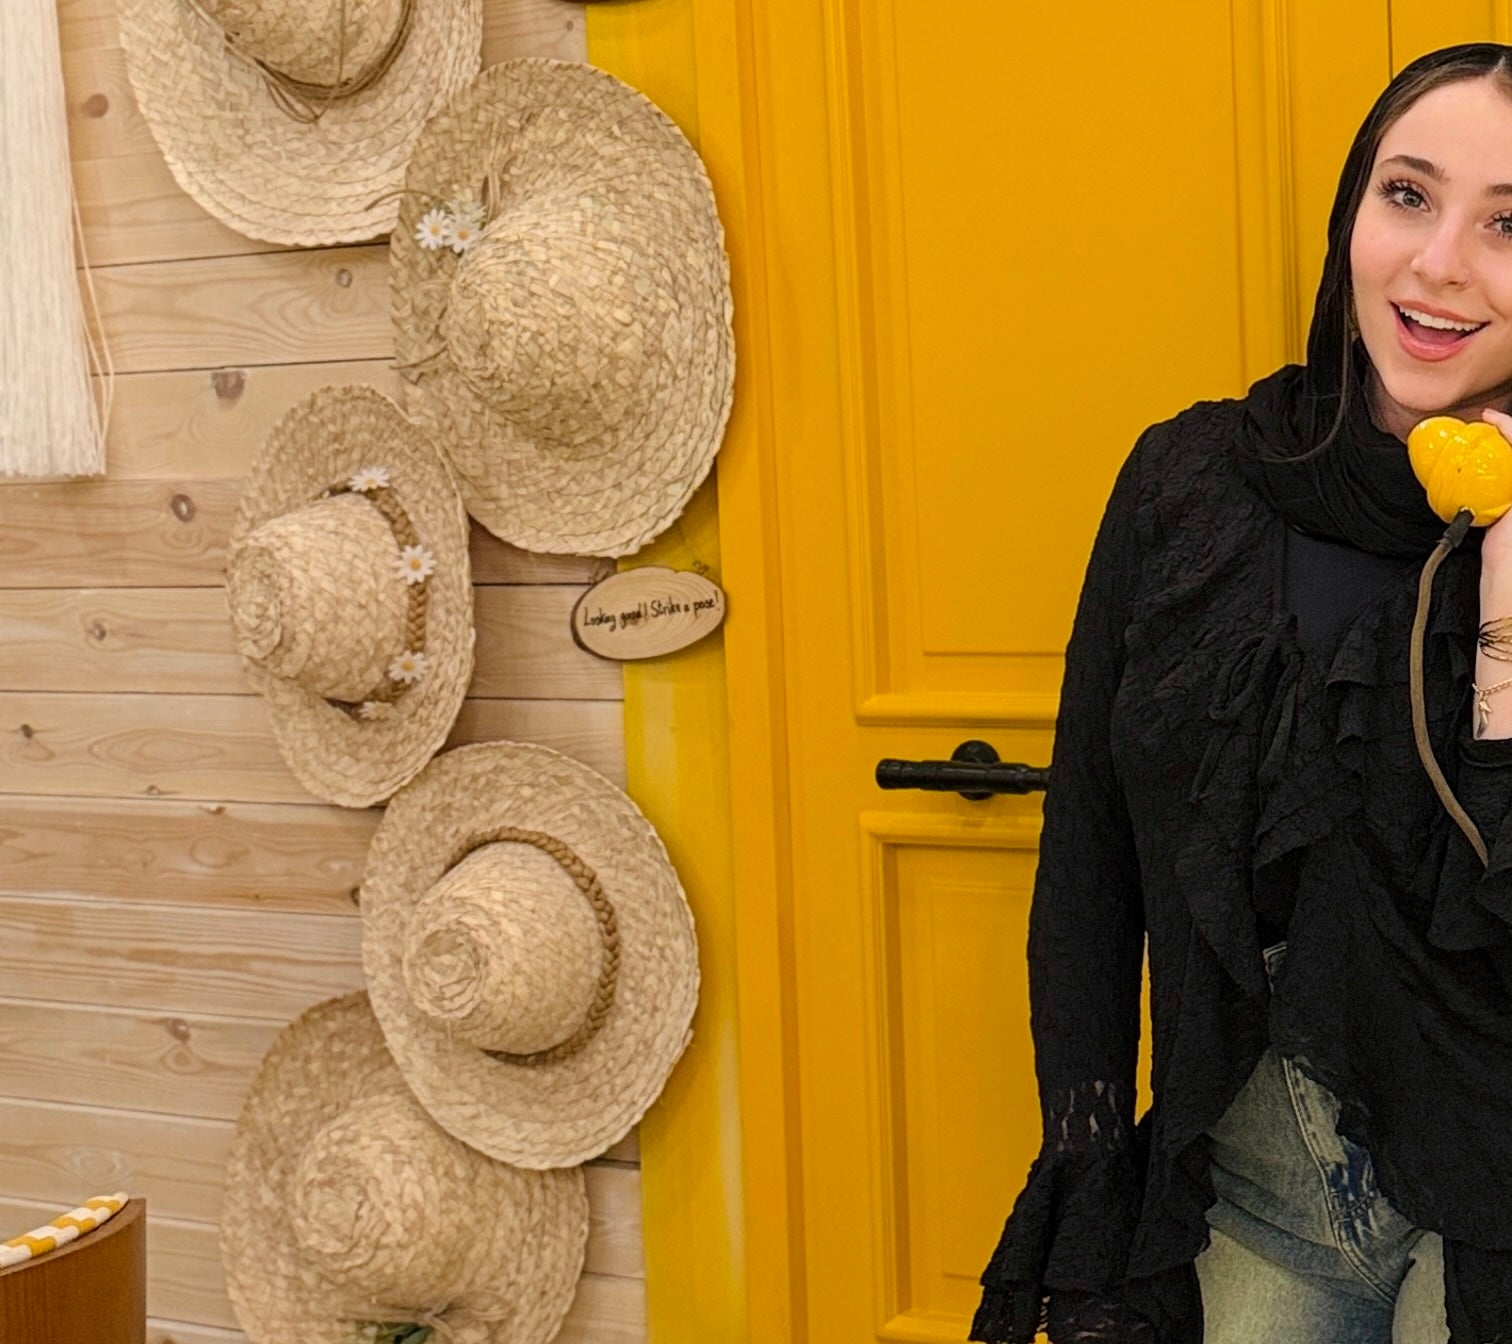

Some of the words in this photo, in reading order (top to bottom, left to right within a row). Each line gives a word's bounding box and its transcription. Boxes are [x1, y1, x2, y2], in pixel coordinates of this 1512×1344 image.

[584, 606, 617, 633] Looking
[650, 596, 681, 618] Strike
[692, 589, 719, 619] pose!
